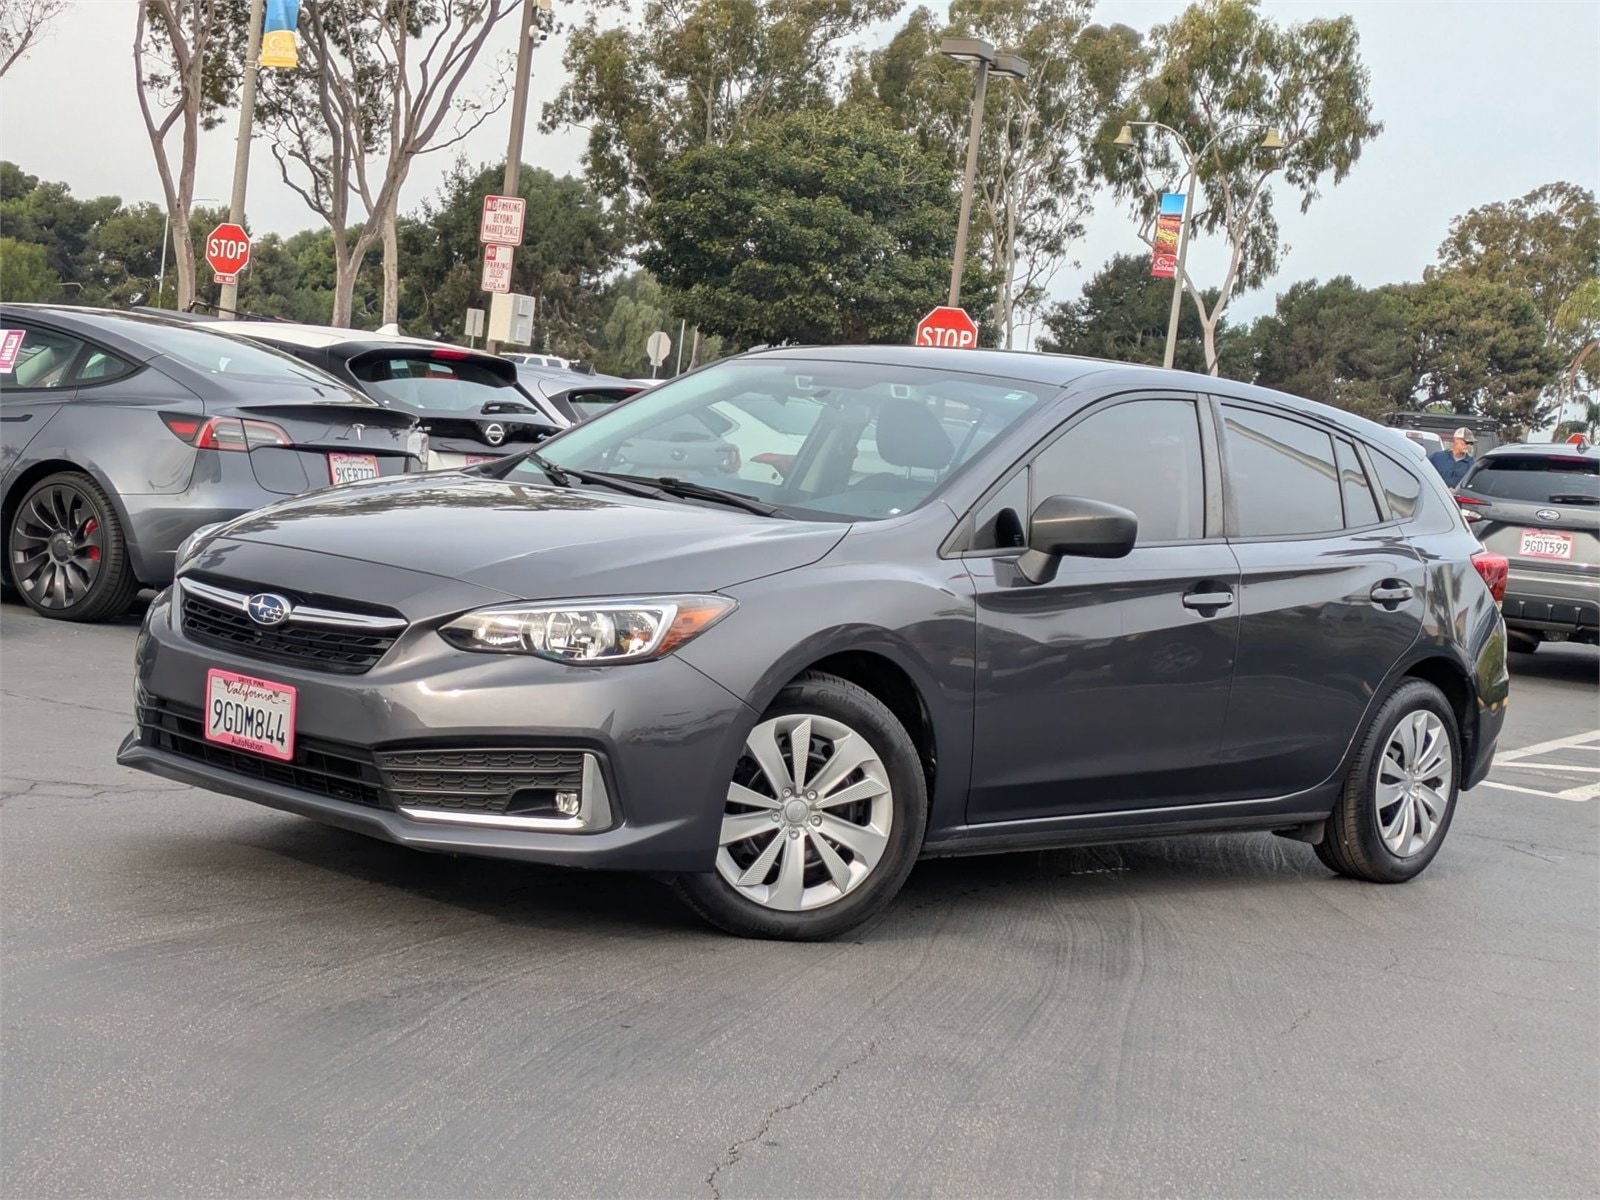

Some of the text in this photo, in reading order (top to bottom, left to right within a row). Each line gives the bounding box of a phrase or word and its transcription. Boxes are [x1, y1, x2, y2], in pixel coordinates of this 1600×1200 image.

[486, 199, 521, 212] NO PARKING
[493, 213, 513, 224] BEYOND
[485, 224, 519, 236] MARKED SPACE
[209, 238, 247, 260] STOP
[487, 247, 496, 257] NO
[486, 261, 509, 270] PARKING
[921, 326, 973, 347] STOP
[1524, 540, 1568, 554] 9GDT599
[238, 677, 252, 685] DRIVE
[226, 680, 278, 704] California
[213, 699, 285, 746] 9GDM844
[231, 736, 264, 752] AutoNation
